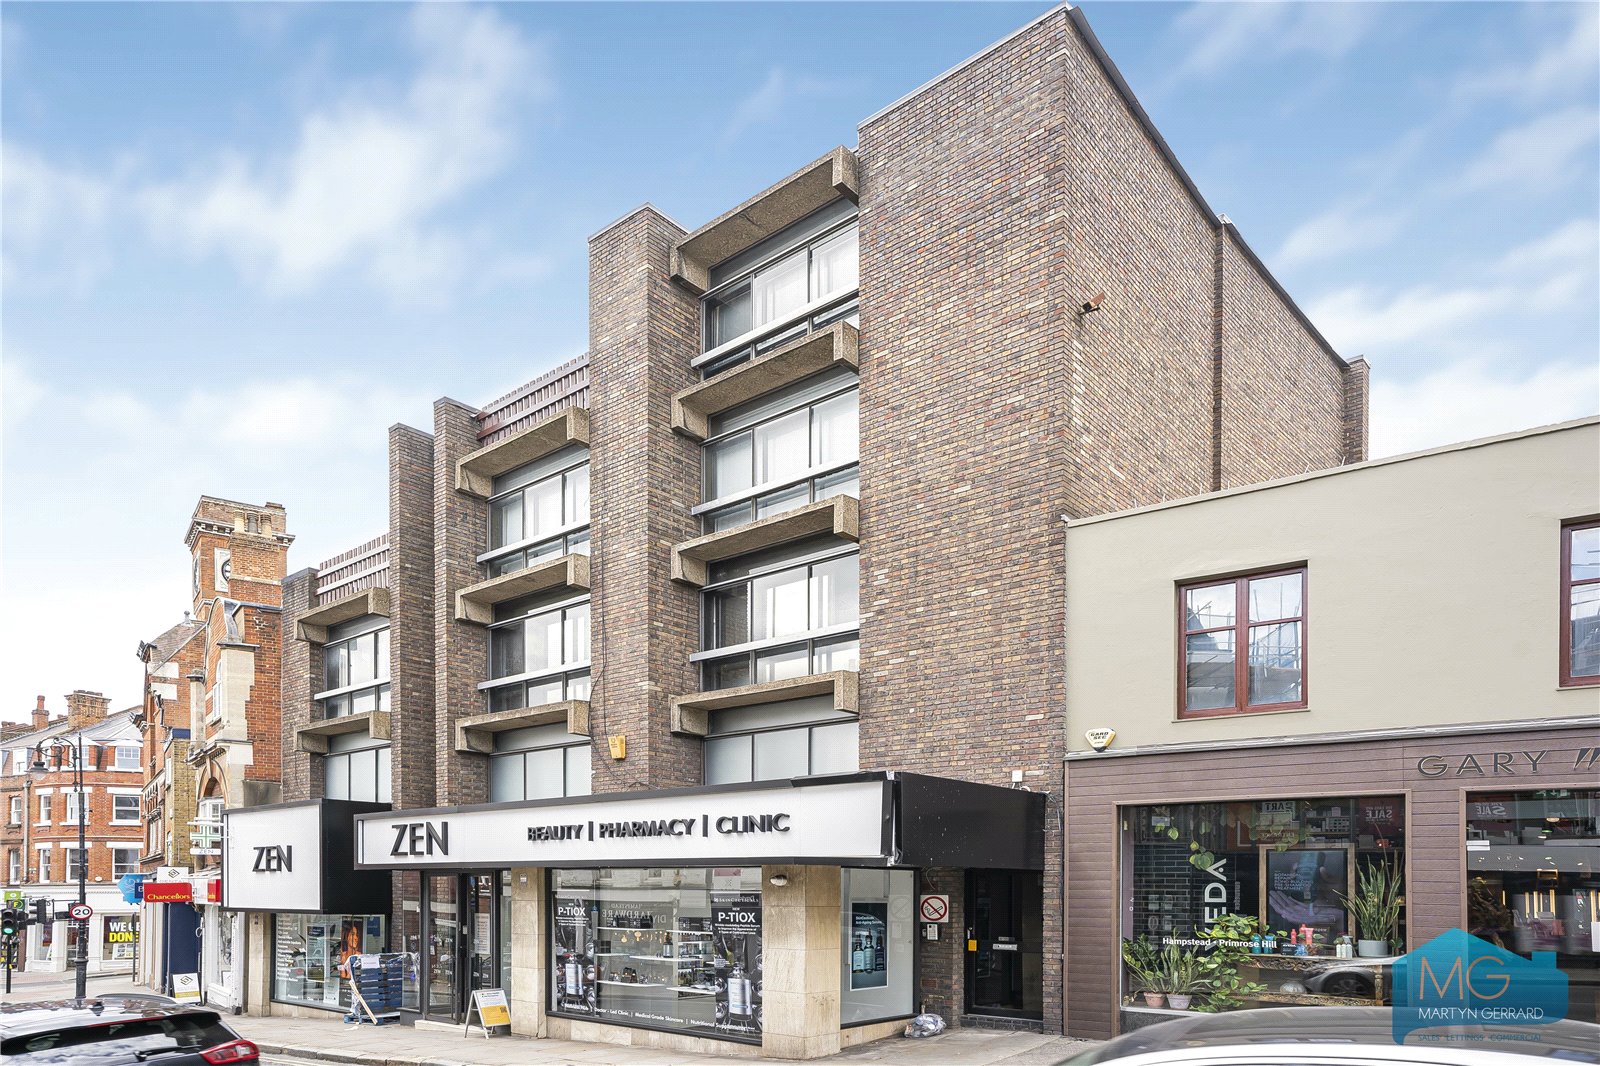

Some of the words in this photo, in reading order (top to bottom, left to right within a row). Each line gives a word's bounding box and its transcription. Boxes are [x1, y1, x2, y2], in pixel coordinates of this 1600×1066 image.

[1417, 750, 1548, 778] GARY
[527, 823, 584, 841] BEAUTY
[599, 818, 696, 839] PHARMACY
[715, 812, 791, 834] CLINIC
[389, 821, 449, 856] ZEN
[252, 845, 293, 873] ZEN
[558, 906, 586, 916] P-TIOX
[718, 912, 756, 923] P-TIOX
[109, 922, 127, 932] WE
[1162, 937, 1211, 946] Hampstead
[1219, 939, 1260, 947] Primrose
[1262, 940, 1277, 949] Hill
